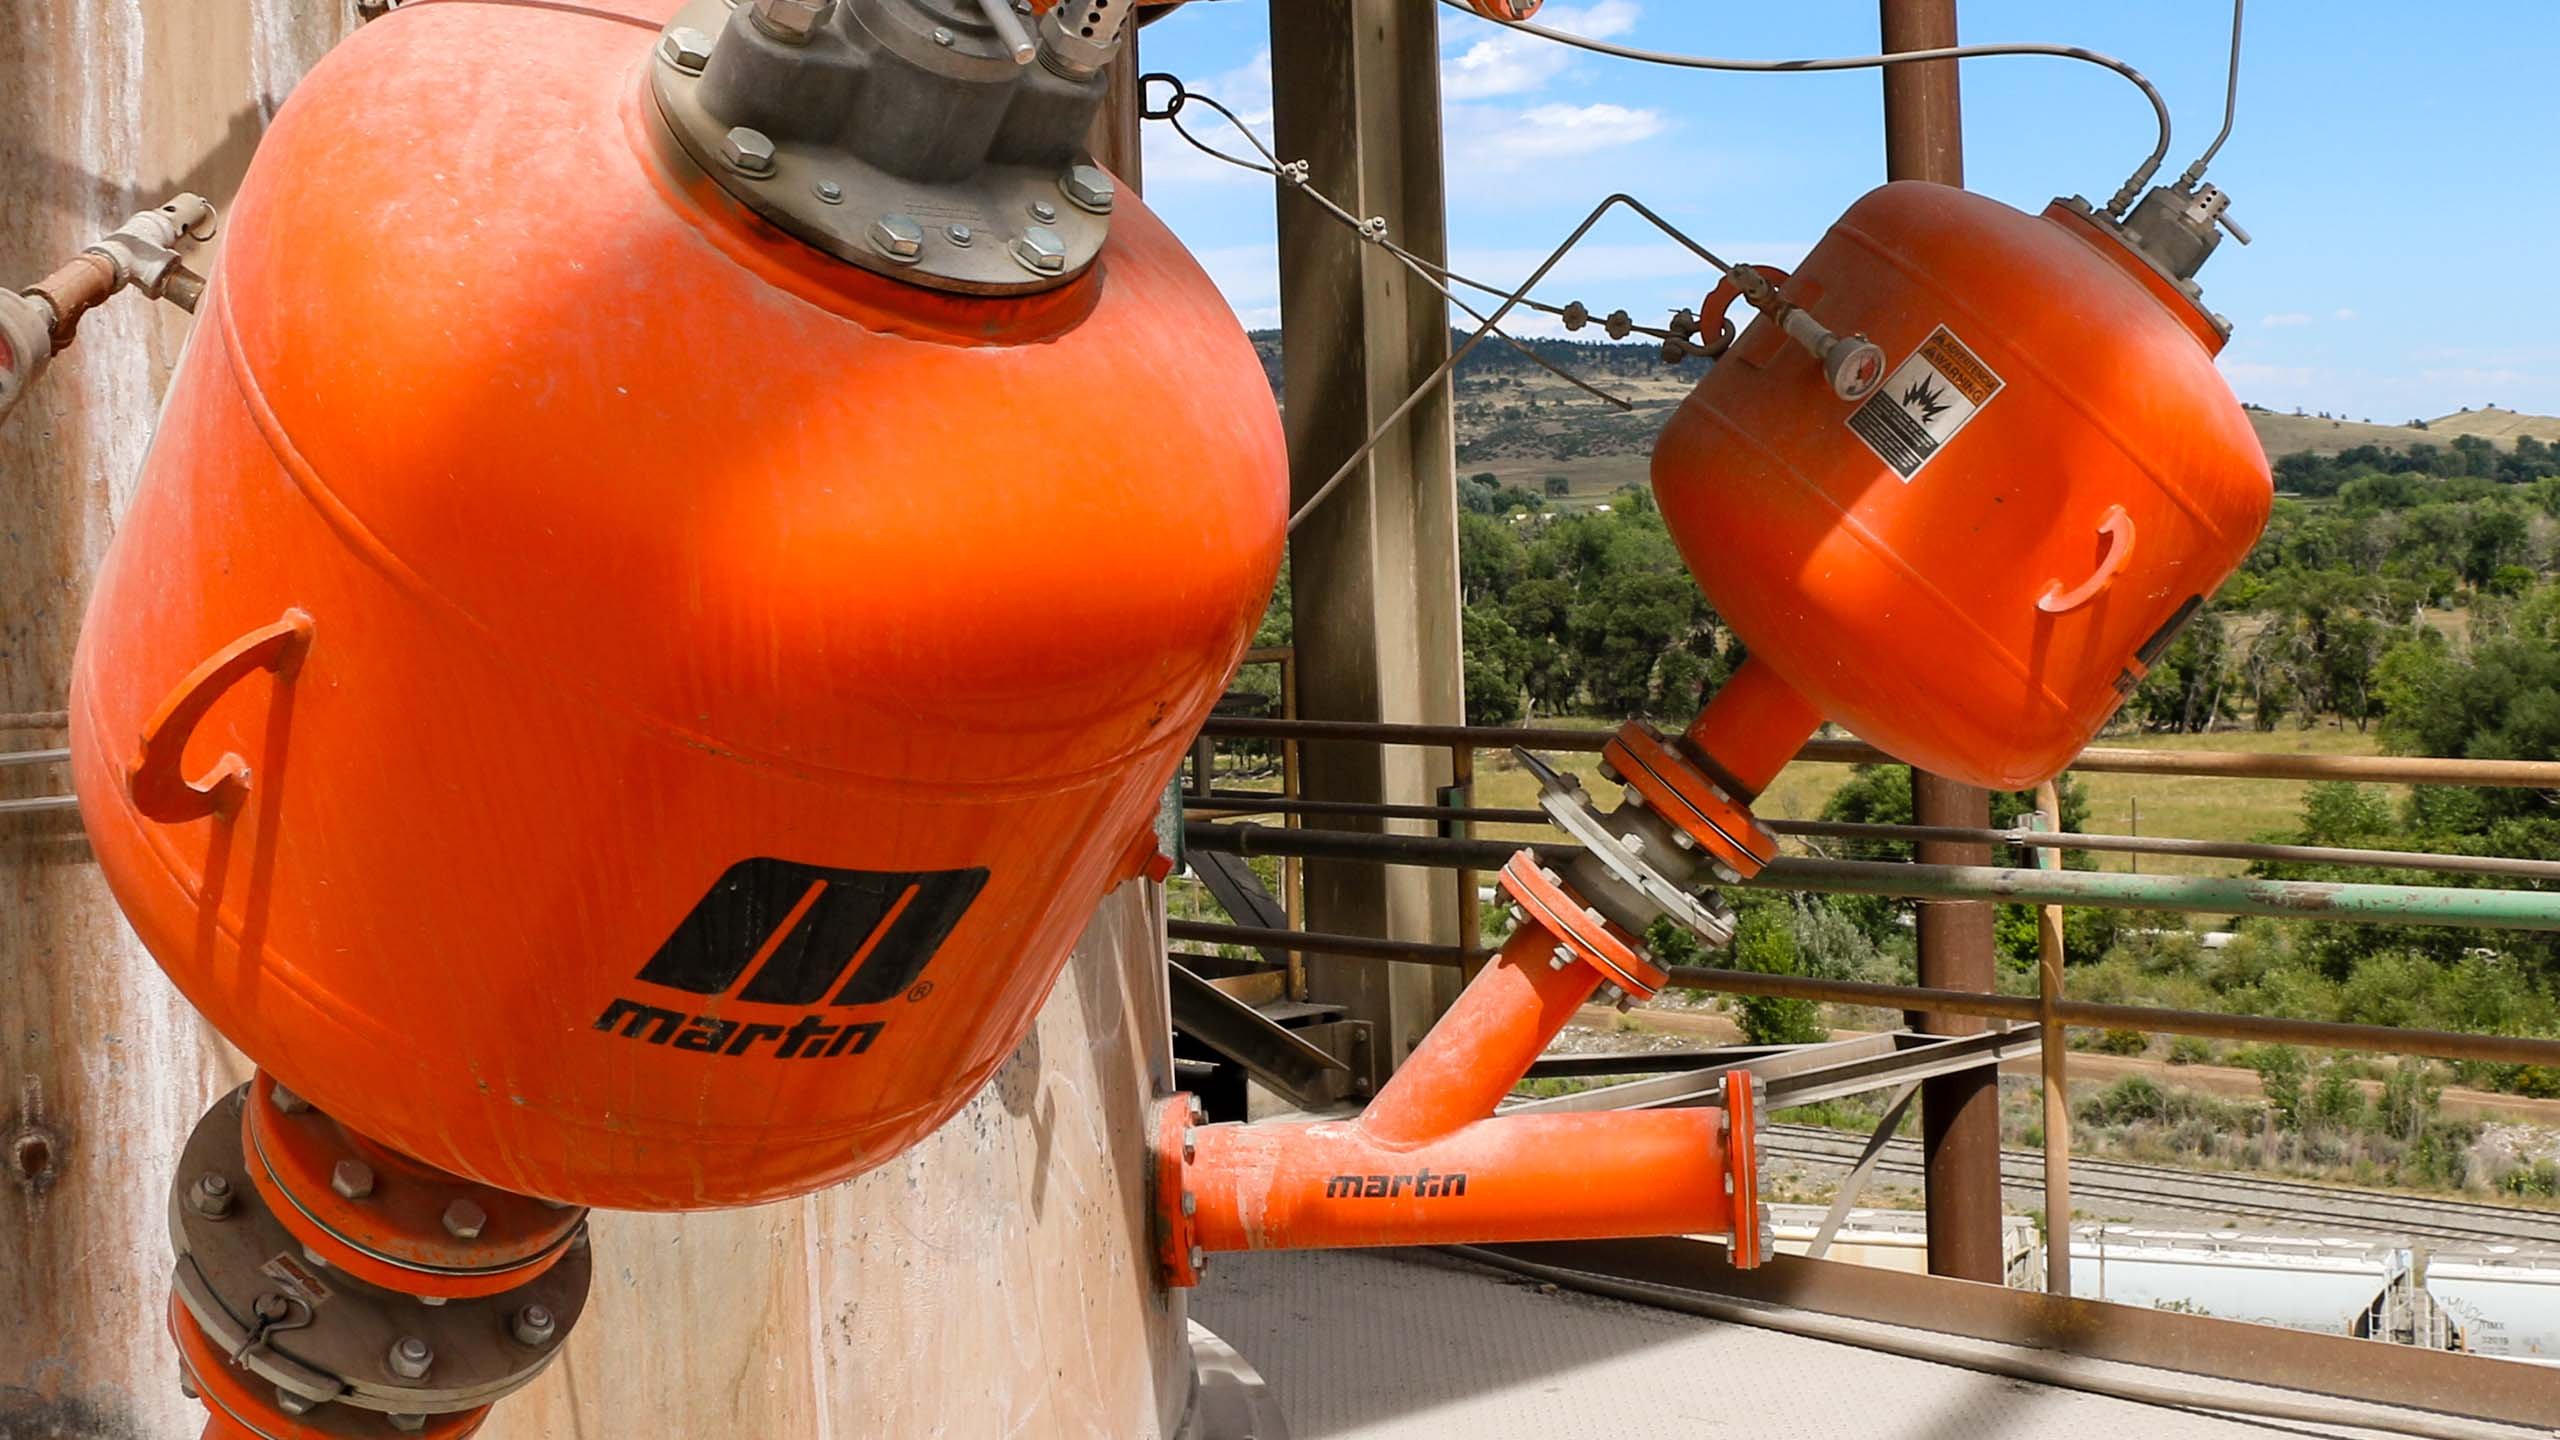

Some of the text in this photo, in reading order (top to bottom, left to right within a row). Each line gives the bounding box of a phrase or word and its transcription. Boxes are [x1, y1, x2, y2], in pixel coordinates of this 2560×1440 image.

[1934, 351, 1984, 402] WARNING
[592, 998, 886, 1059] martin
[1326, 1168, 1467, 1198] martin
